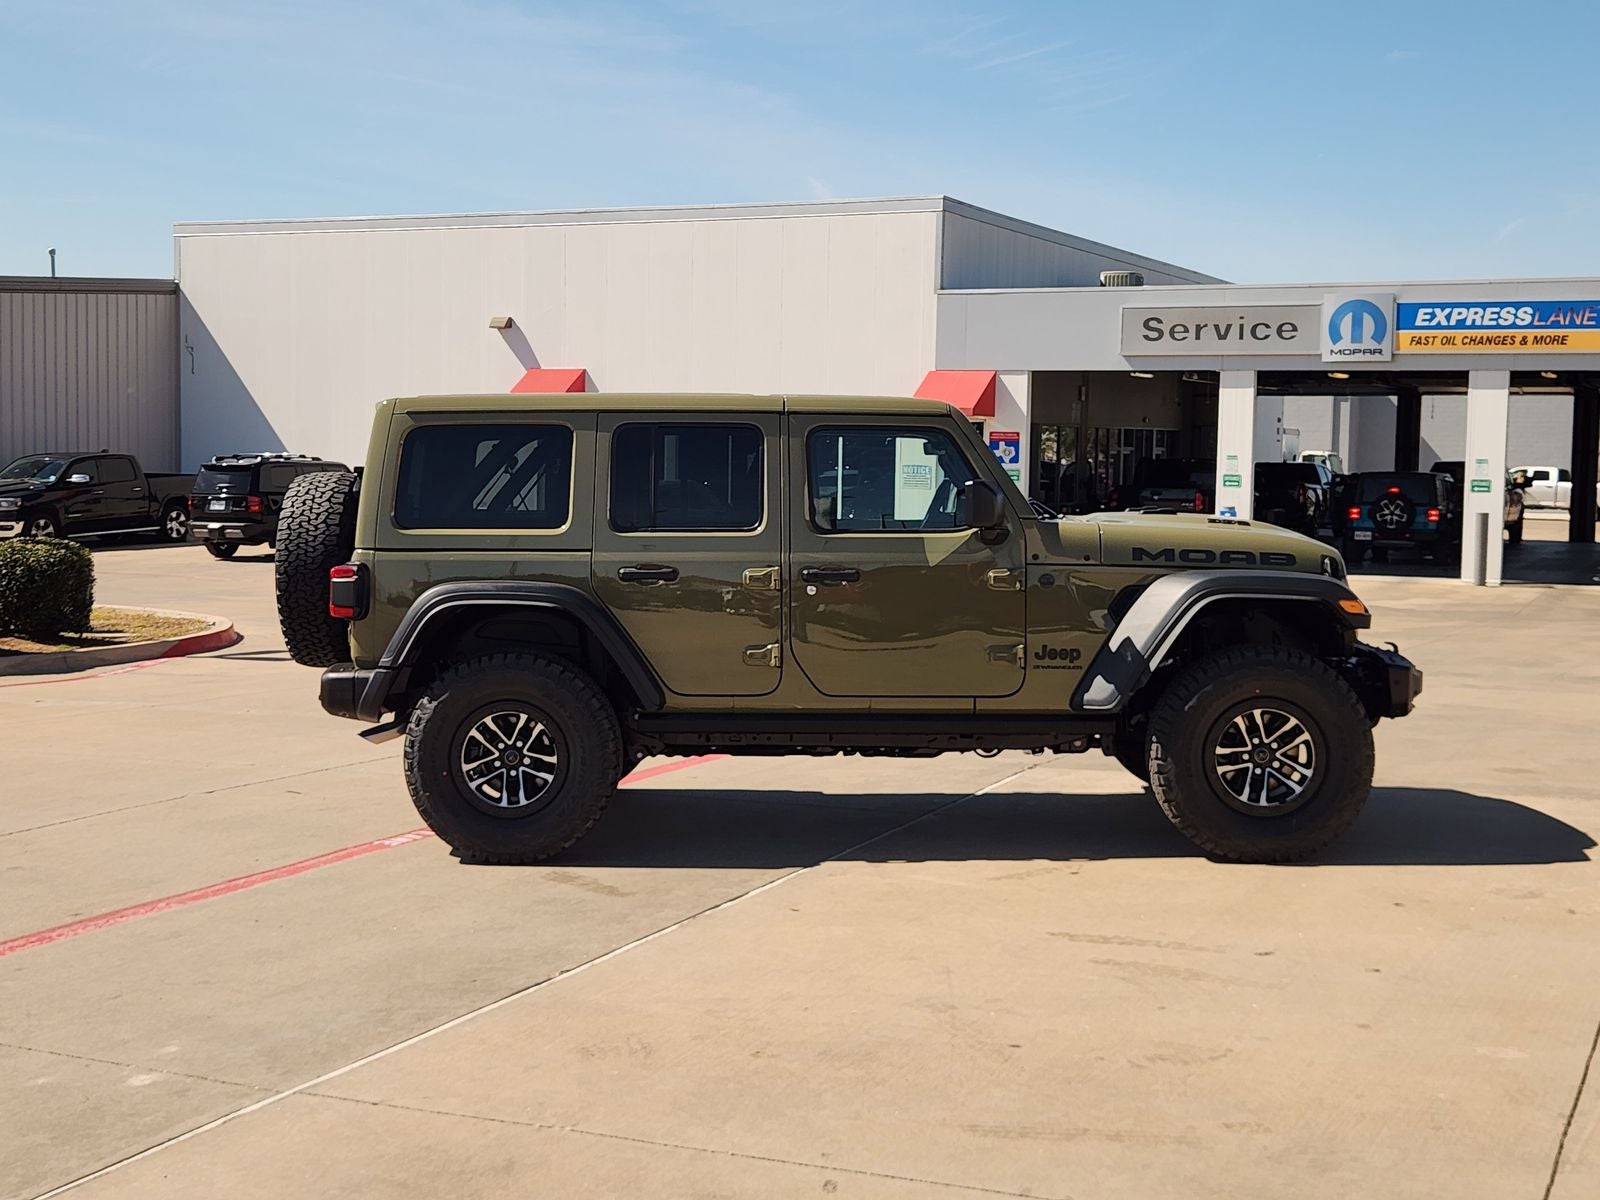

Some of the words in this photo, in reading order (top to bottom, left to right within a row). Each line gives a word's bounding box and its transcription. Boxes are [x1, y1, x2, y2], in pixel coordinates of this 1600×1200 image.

[1142, 316, 1298, 342] Service
[1409, 336, 1438, 346] FAST
[1440, 336, 1458, 346] OIL
[1461, 335, 1516, 346] CHANGES
[1519, 335, 1529, 346] &
[1532, 335, 1569, 346] MORE
[1329, 348, 1384, 356] MOPAR
[903, 465, 931, 474] NOTICE
[1131, 547, 1297, 566] MOAB
[1034, 644, 1081, 664] Jeep
